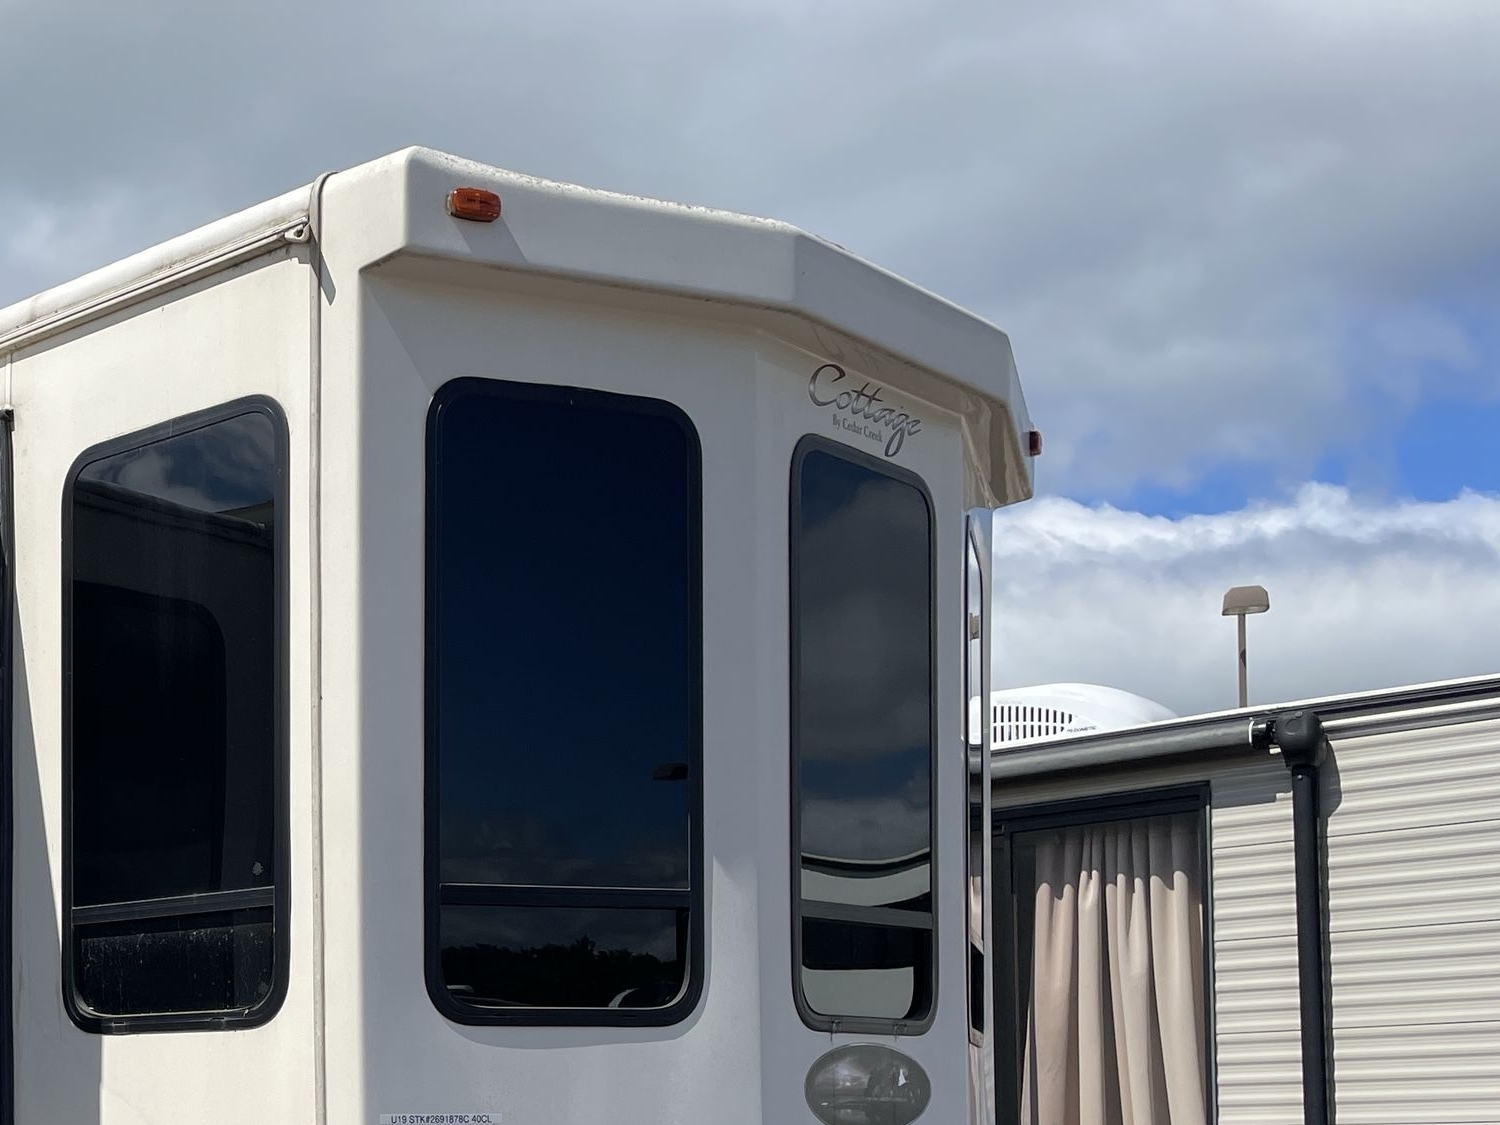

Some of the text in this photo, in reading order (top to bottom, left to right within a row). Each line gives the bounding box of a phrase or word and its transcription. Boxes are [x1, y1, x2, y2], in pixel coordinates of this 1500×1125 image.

[808, 364, 921, 457] Cottage
[832, 413, 883, 442] By Cedar Creek
[390, 1115, 407, 1124] U19
[471, 1114, 493, 1124] 40CL
